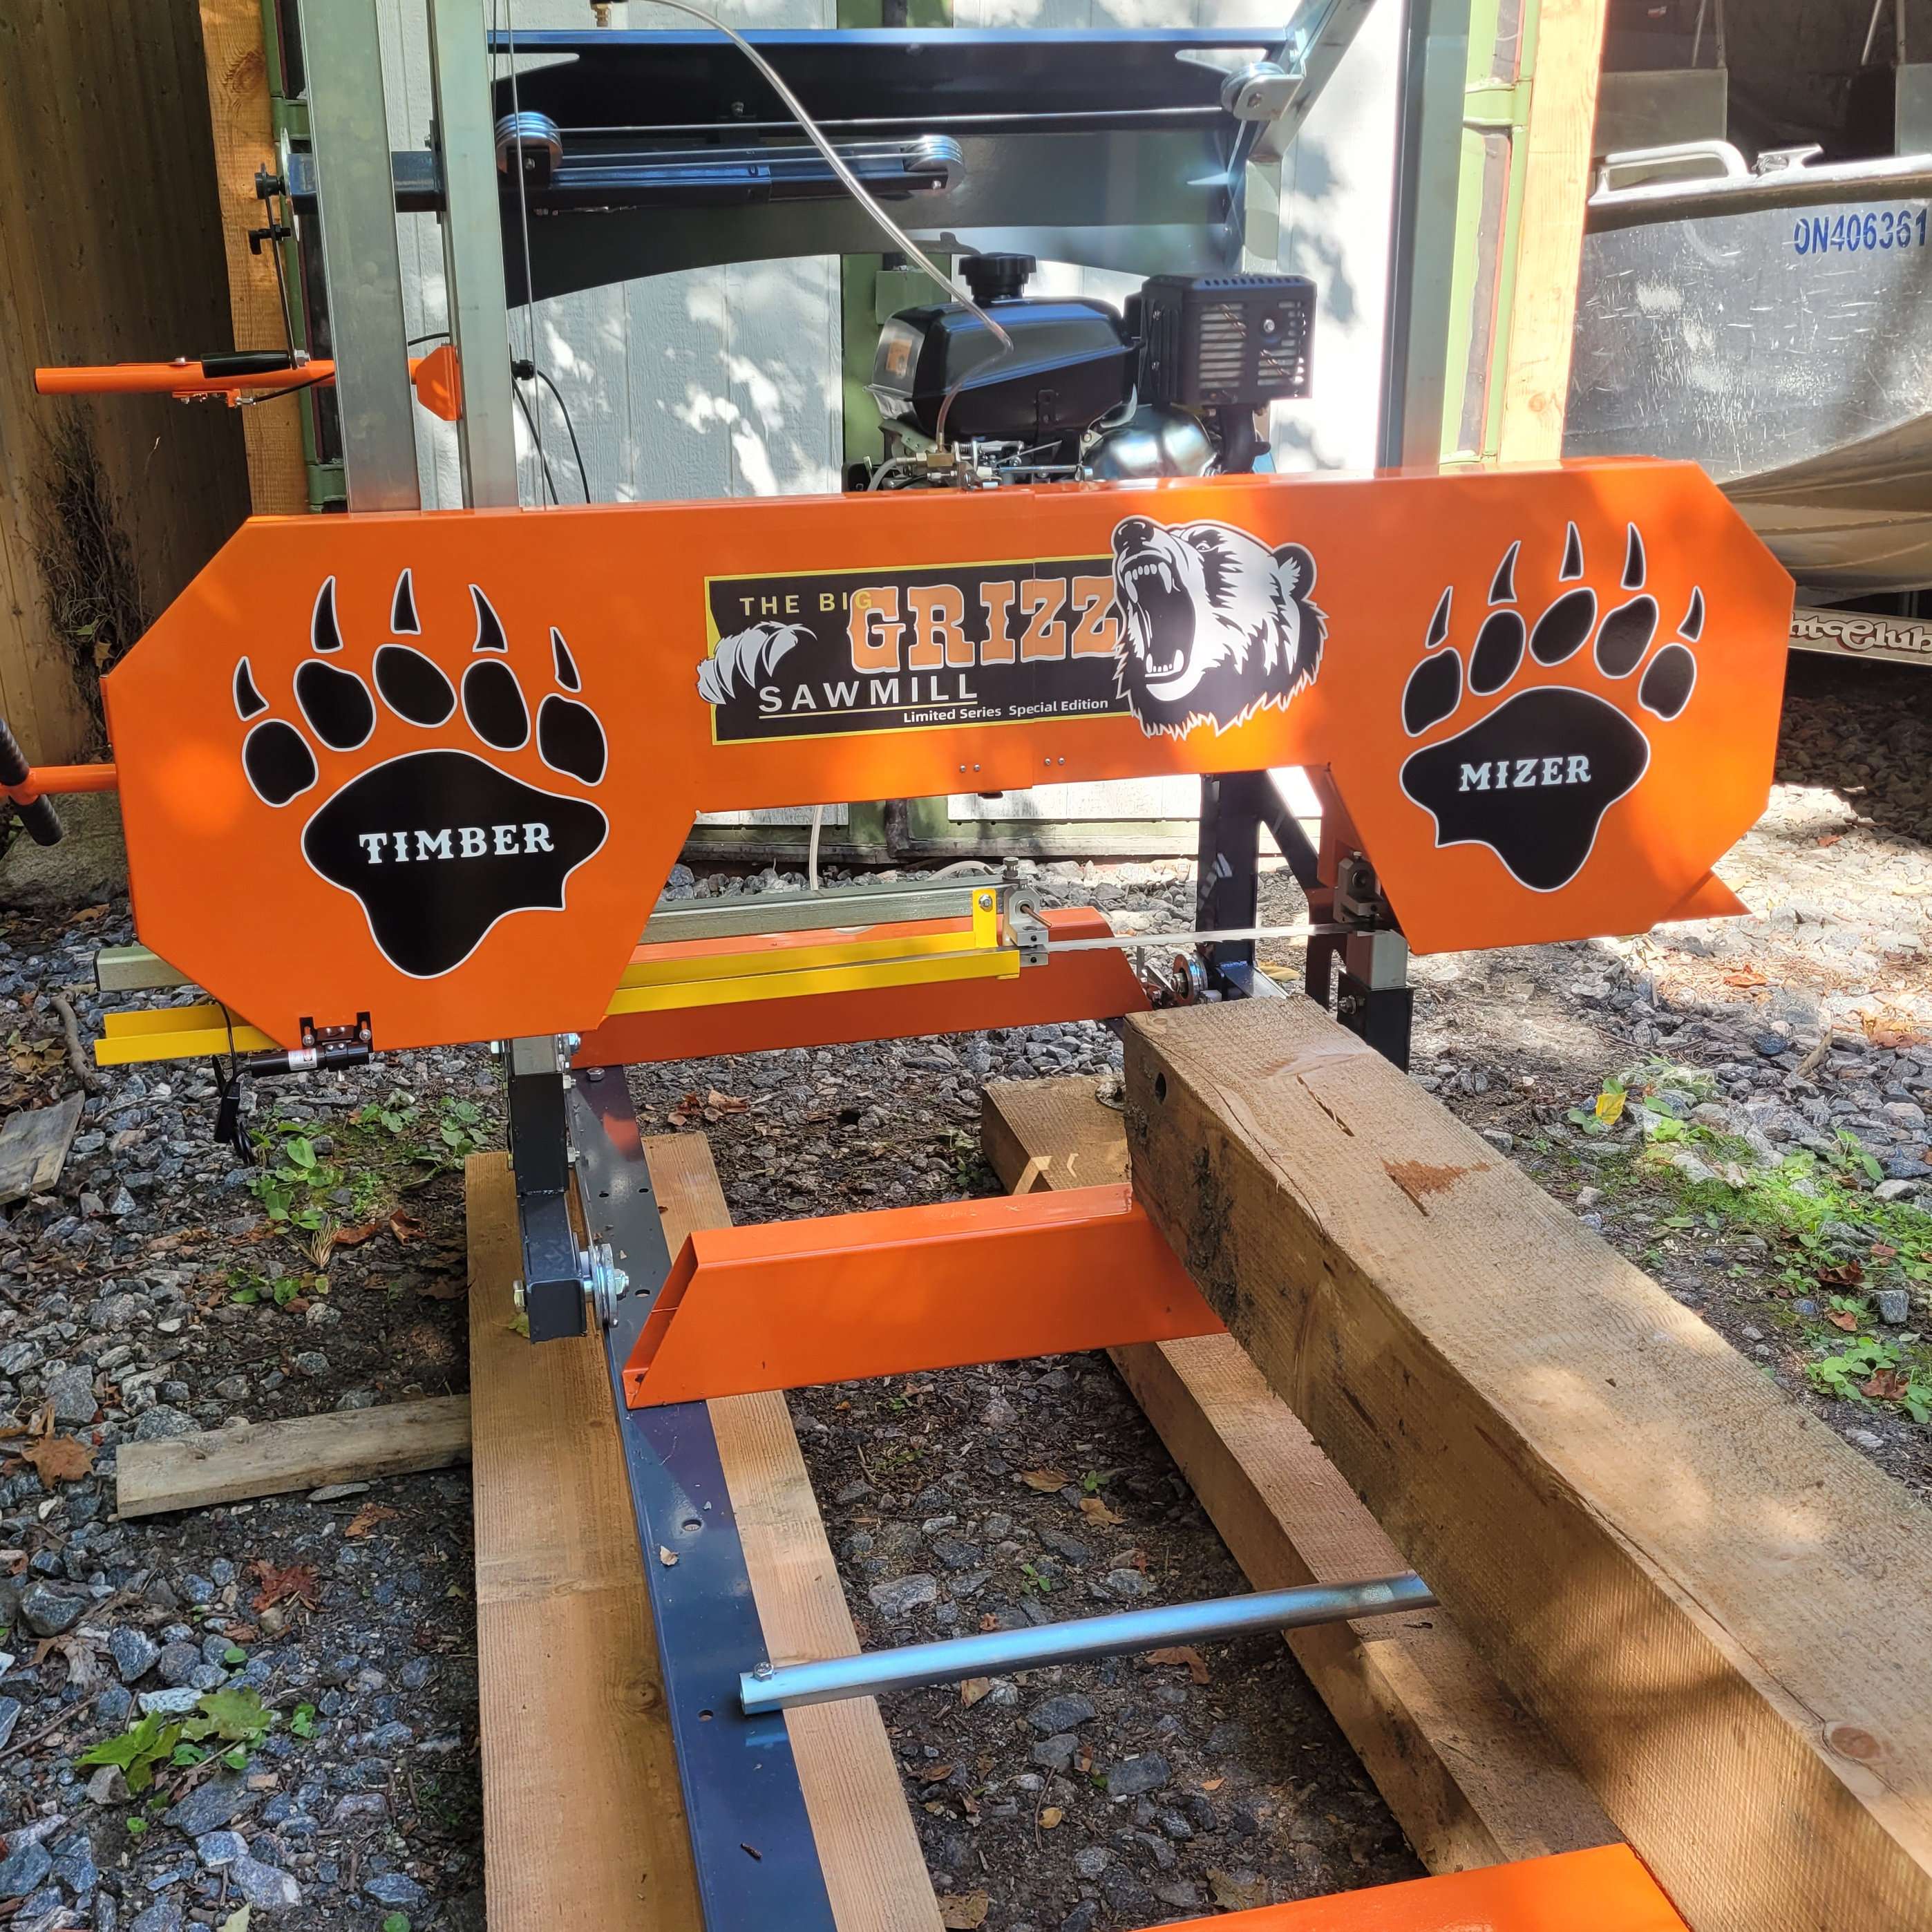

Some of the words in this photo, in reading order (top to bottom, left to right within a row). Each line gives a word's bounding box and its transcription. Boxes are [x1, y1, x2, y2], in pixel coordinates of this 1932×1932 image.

[1794, 208, 1928, 255] ON406361
[739, 594, 800, 616] THE
[820, 591, 872, 612] BIG
[846, 576, 1121, 674] GRIZZ
[758, 674, 978, 712] SAWMILL
[903, 709, 956, 723] Limited
[960, 706, 1002, 719] Series
[1008, 701, 1058, 718] Special
[1061, 699, 1109, 712] Edition
[1459, 755, 1592, 792] MIZER
[359, 822, 555, 864] TIMBER
